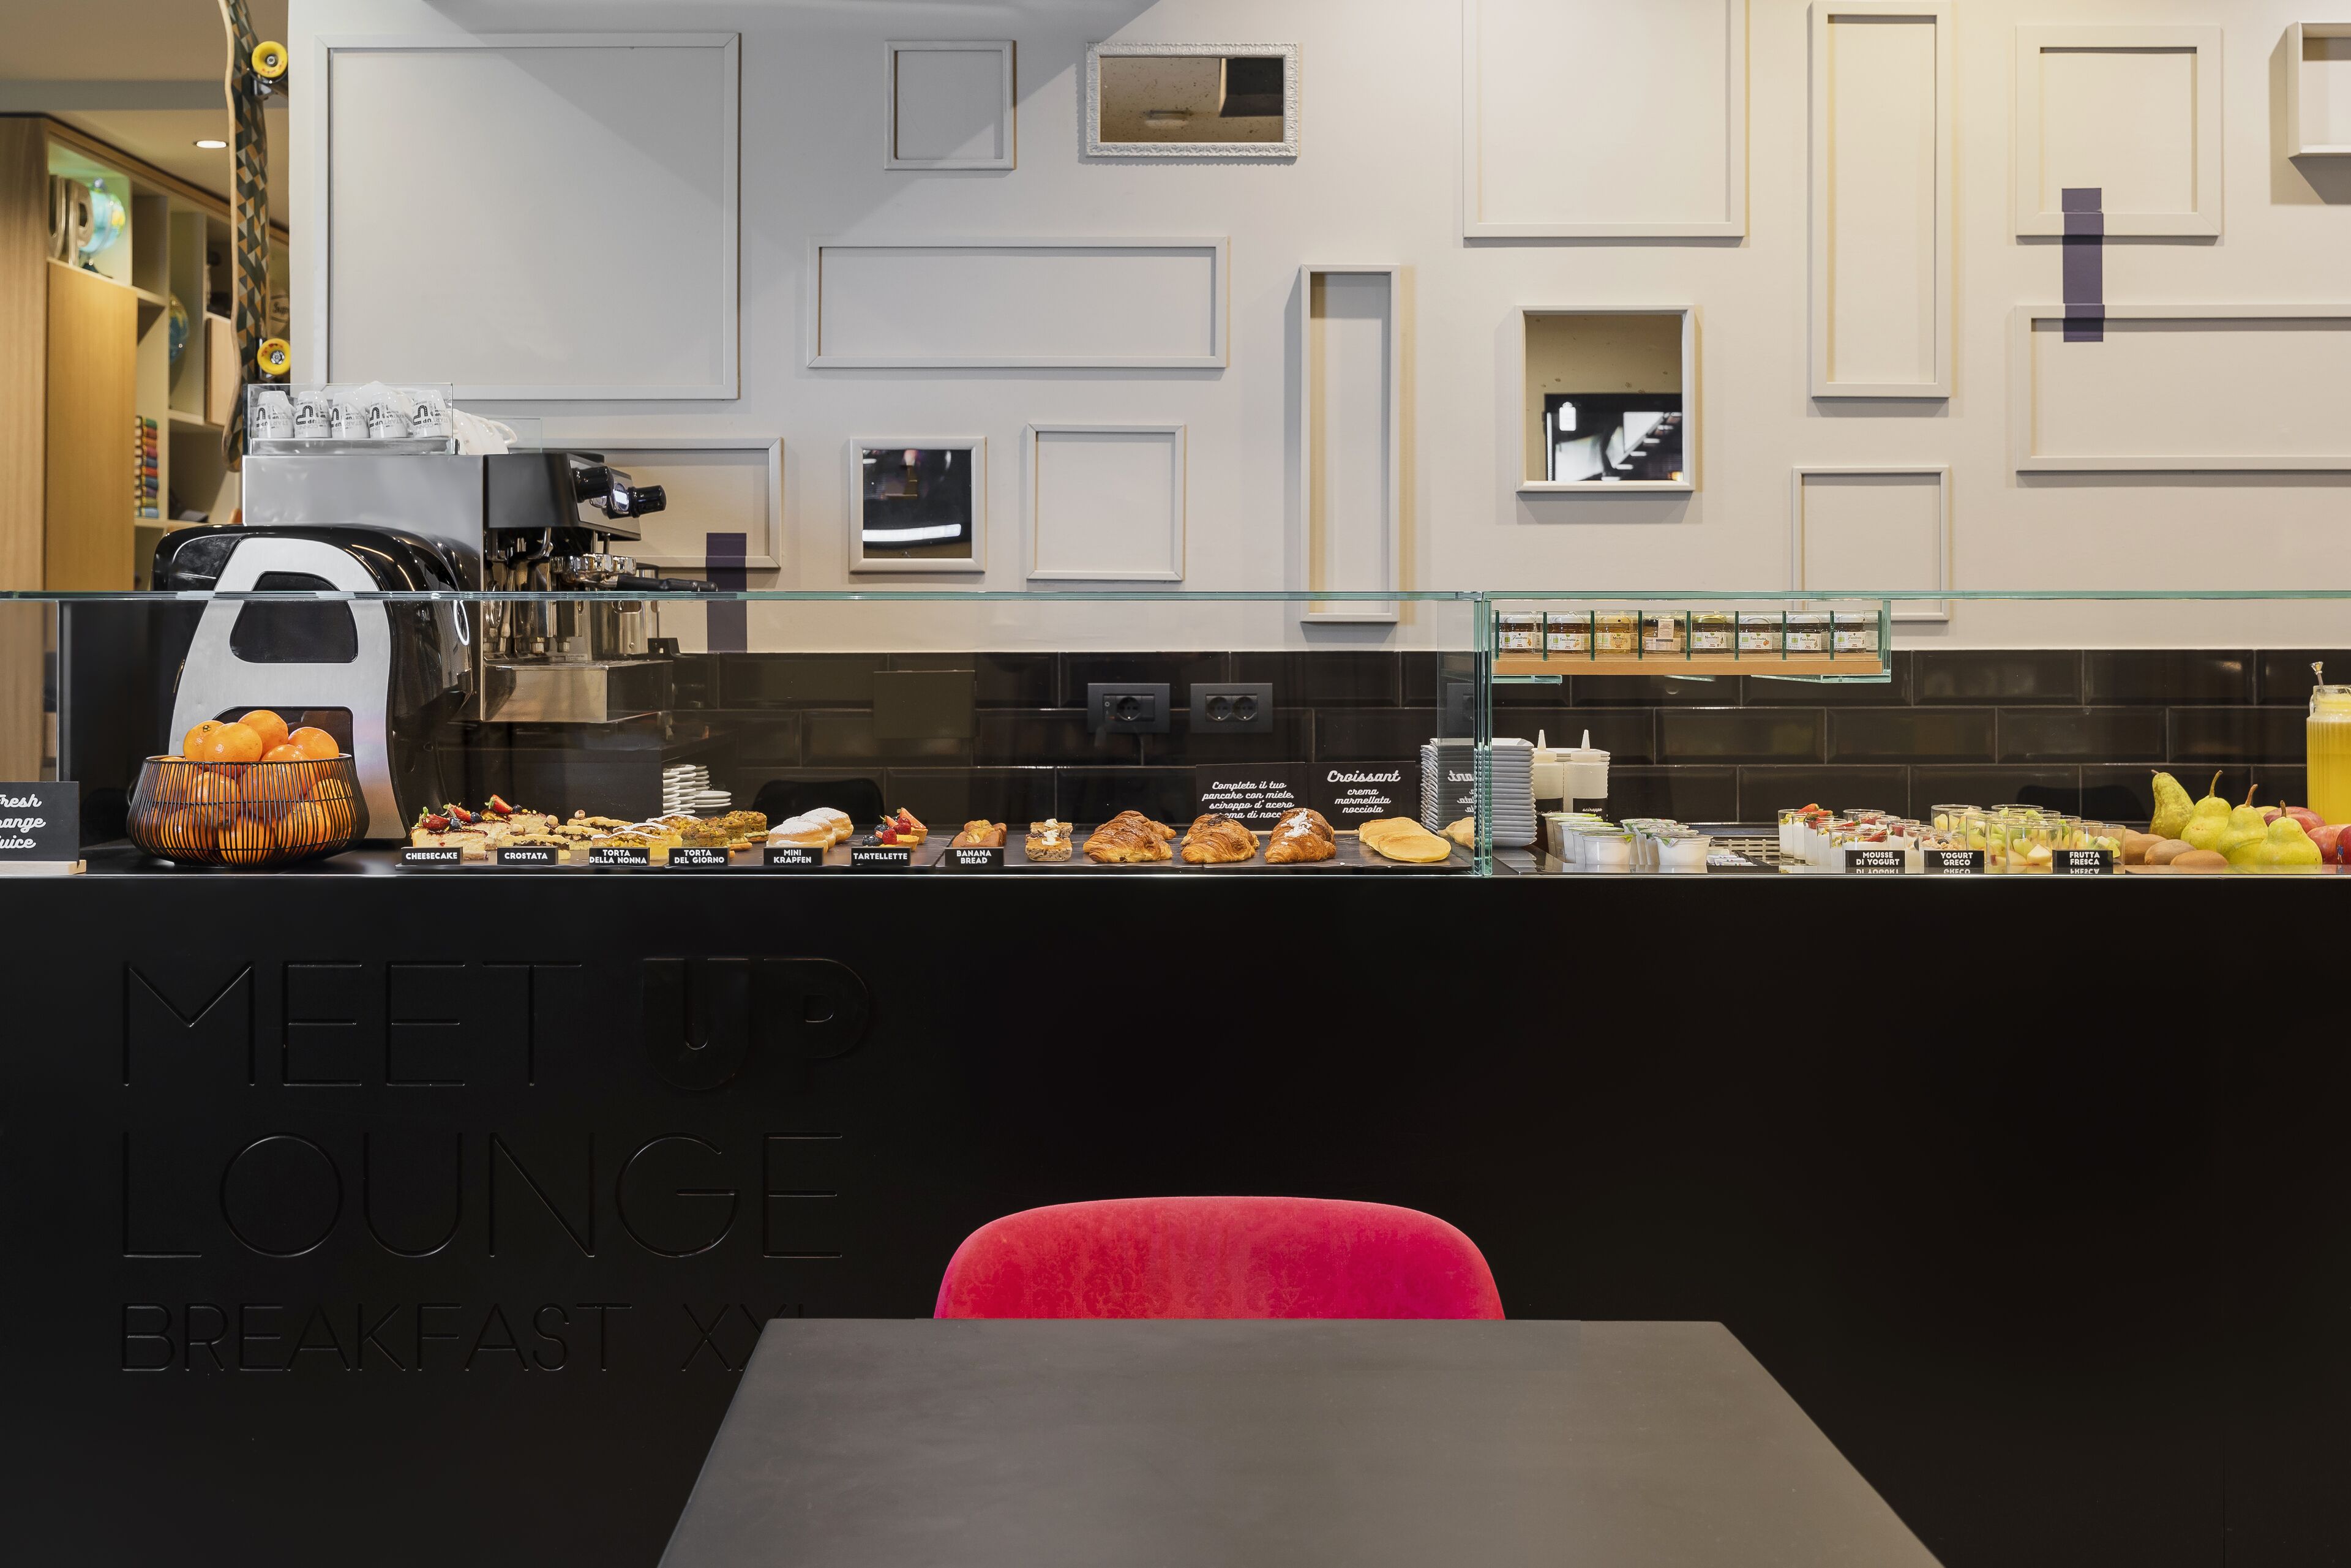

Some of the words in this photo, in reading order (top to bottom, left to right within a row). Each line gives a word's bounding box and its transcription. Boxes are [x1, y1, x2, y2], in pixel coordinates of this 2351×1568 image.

[1327, 770, 1401, 782] Croissant
[1212, 781, 1258, 791] Completa
[1259, 781, 1267, 789] il
[1201, 791, 1244, 801] pancake
[1265, 790, 1294, 799] miele,
[1335, 796, 1392, 805] marmellata
[1209, 801, 1253, 811] sciroppo
[1342, 805, 1384, 813] nocciola
[1247, 810, 1258, 819] di
[0, 817, 47, 833] ange
[0, 835, 37, 849] uice
[405, 852, 458, 860] CHEESECAKE
[122, 961, 582, 1087] MEET
[642, 956, 872, 1093] UP
[122, 1131, 844, 1259] LOUNGE
[121, 1302, 633, 1371] BREAKFAST
